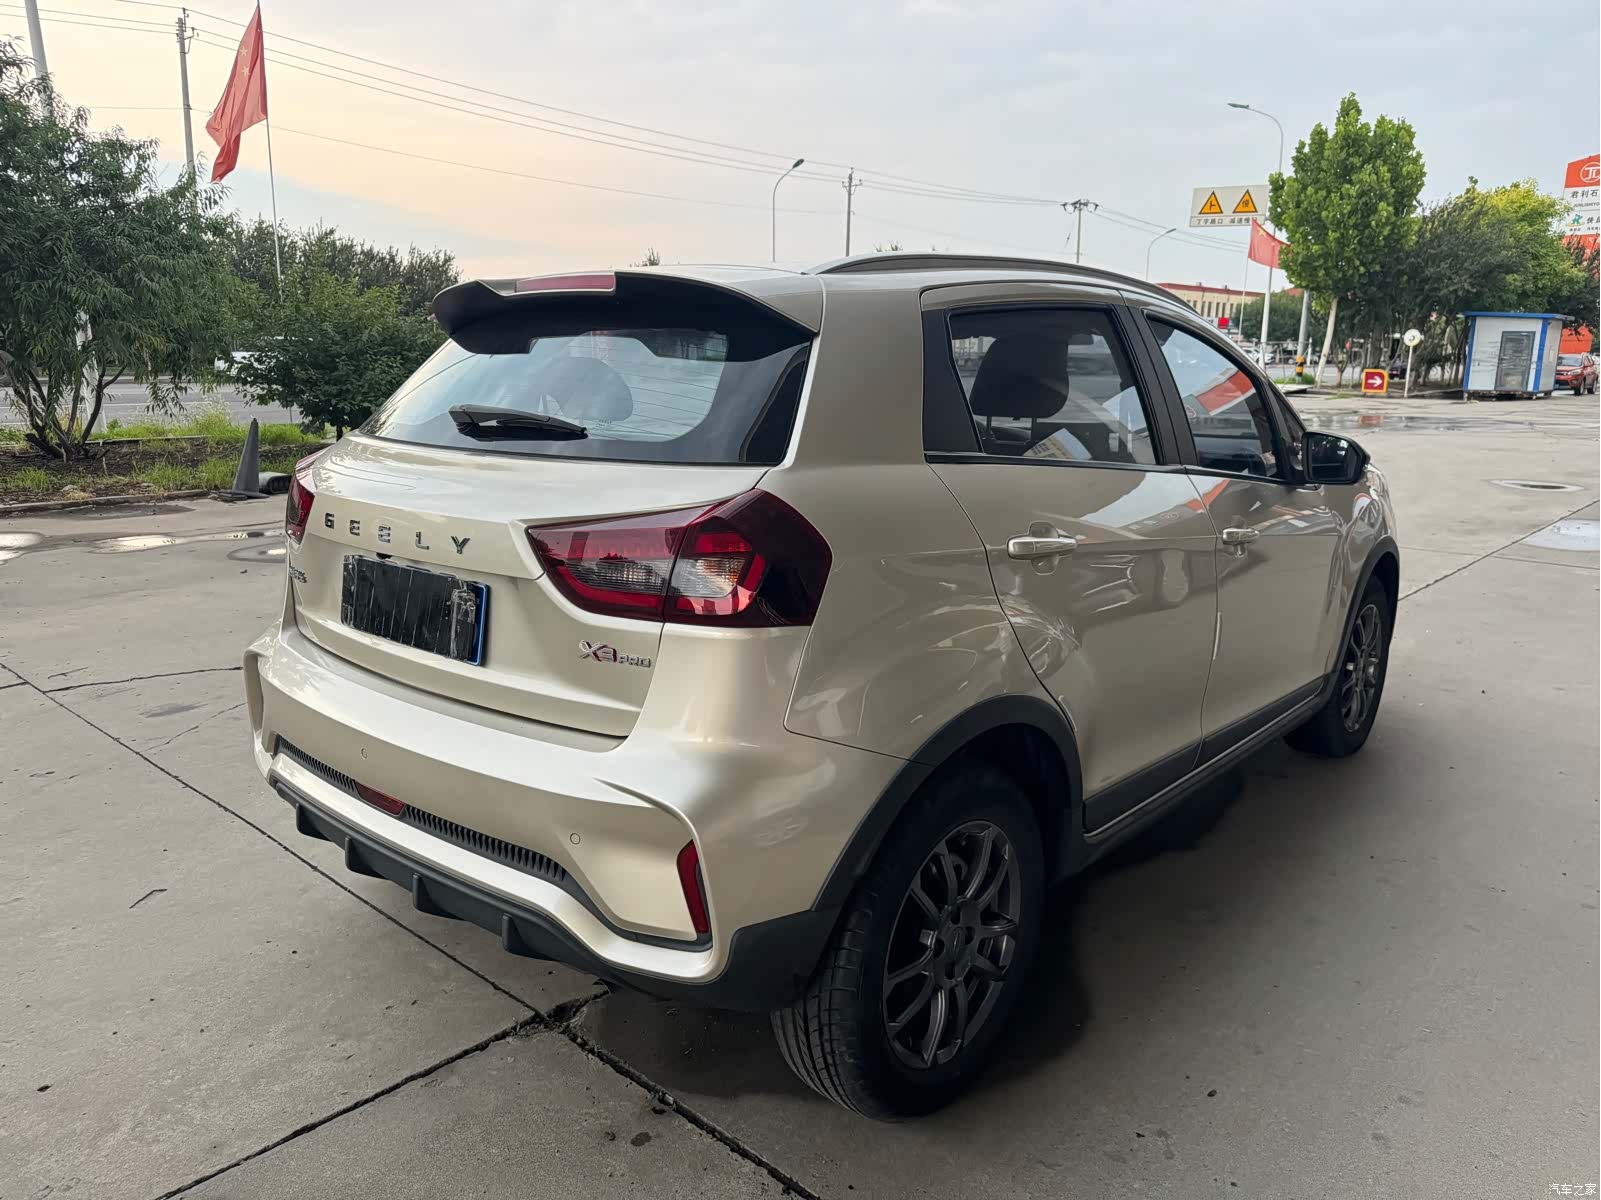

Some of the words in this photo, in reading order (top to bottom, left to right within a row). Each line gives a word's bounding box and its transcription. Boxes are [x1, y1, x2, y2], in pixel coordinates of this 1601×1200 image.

[1570, 189, 1600, 199] 君利石
[324, 512, 471, 555] GEELY
